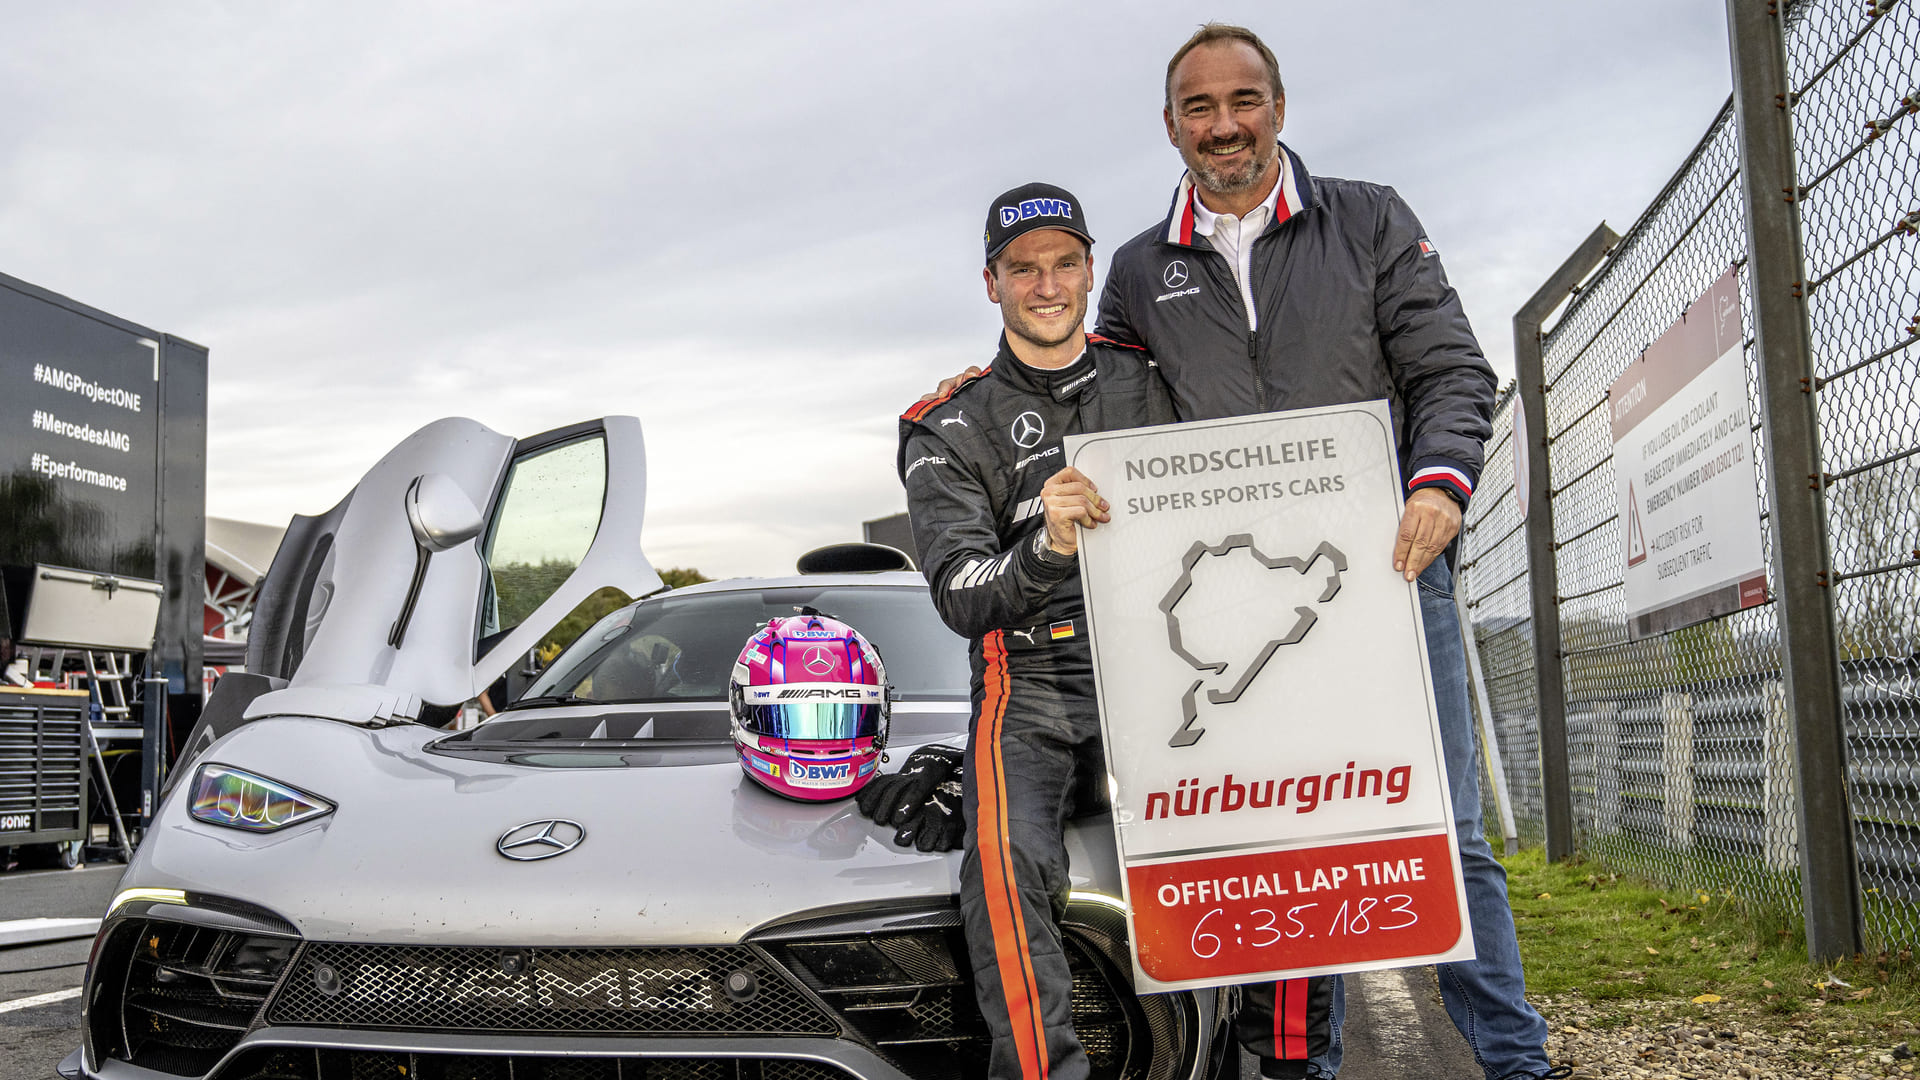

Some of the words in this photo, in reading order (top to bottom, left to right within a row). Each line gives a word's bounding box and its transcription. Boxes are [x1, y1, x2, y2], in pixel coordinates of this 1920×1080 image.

[1019, 198, 1072, 221] BWT
[33, 362, 141, 412] #AMGProjectONE
[1614, 376, 1647, 422] ATTENTION
[32, 409, 130, 453] #MercedesAMG
[1642, 445, 1647, 461] IF
[1647, 438, 1658, 457] YOU
[1658, 427, 1671, 450] LOSE
[1671, 421, 1681, 440] OIL
[1681, 414, 1690, 433] OR
[1690, 391, 1719, 427] COOLANT
[1644, 463, 1662, 488] PLEASE
[1662, 454, 1675, 477] STOP
[1675, 428, 1713, 468] IMMEDIATELY
[1714, 418, 1728, 442] AND
[1729, 407, 1746, 433] CALL
[31, 452, 127, 492] #Eperformance
[1125, 438, 1337, 481] NORDSCHLEIFE
[1646, 484, 1676, 514] EMERGENCY
[1677, 469, 1701, 497] NUMBER
[1700, 459, 1716, 484] 0800
[1716, 450, 1732, 474] 0302
[1731, 442, 1745, 465] 112!
[1127, 491, 1197, 515] SUPER
[1201, 482, 1283, 507] SPORTS
[1288, 474, 1345, 497] CARS
[1655, 527, 1679, 552] ACCIDENT
[1680, 521, 1691, 541] RISK
[1692, 515, 1703, 535] FOR
[1657, 552, 1689, 580] SUBSEQUENT
[1689, 542, 1712, 566] TRAFFIC
[807, 763, 850, 780] BWT
[1145, 761, 1412, 821] nürburgring
[1157, 872, 1289, 907] OFFICIAL
[1294, 866, 1349, 893] LAP
[1353, 858, 1426, 886] TIME
